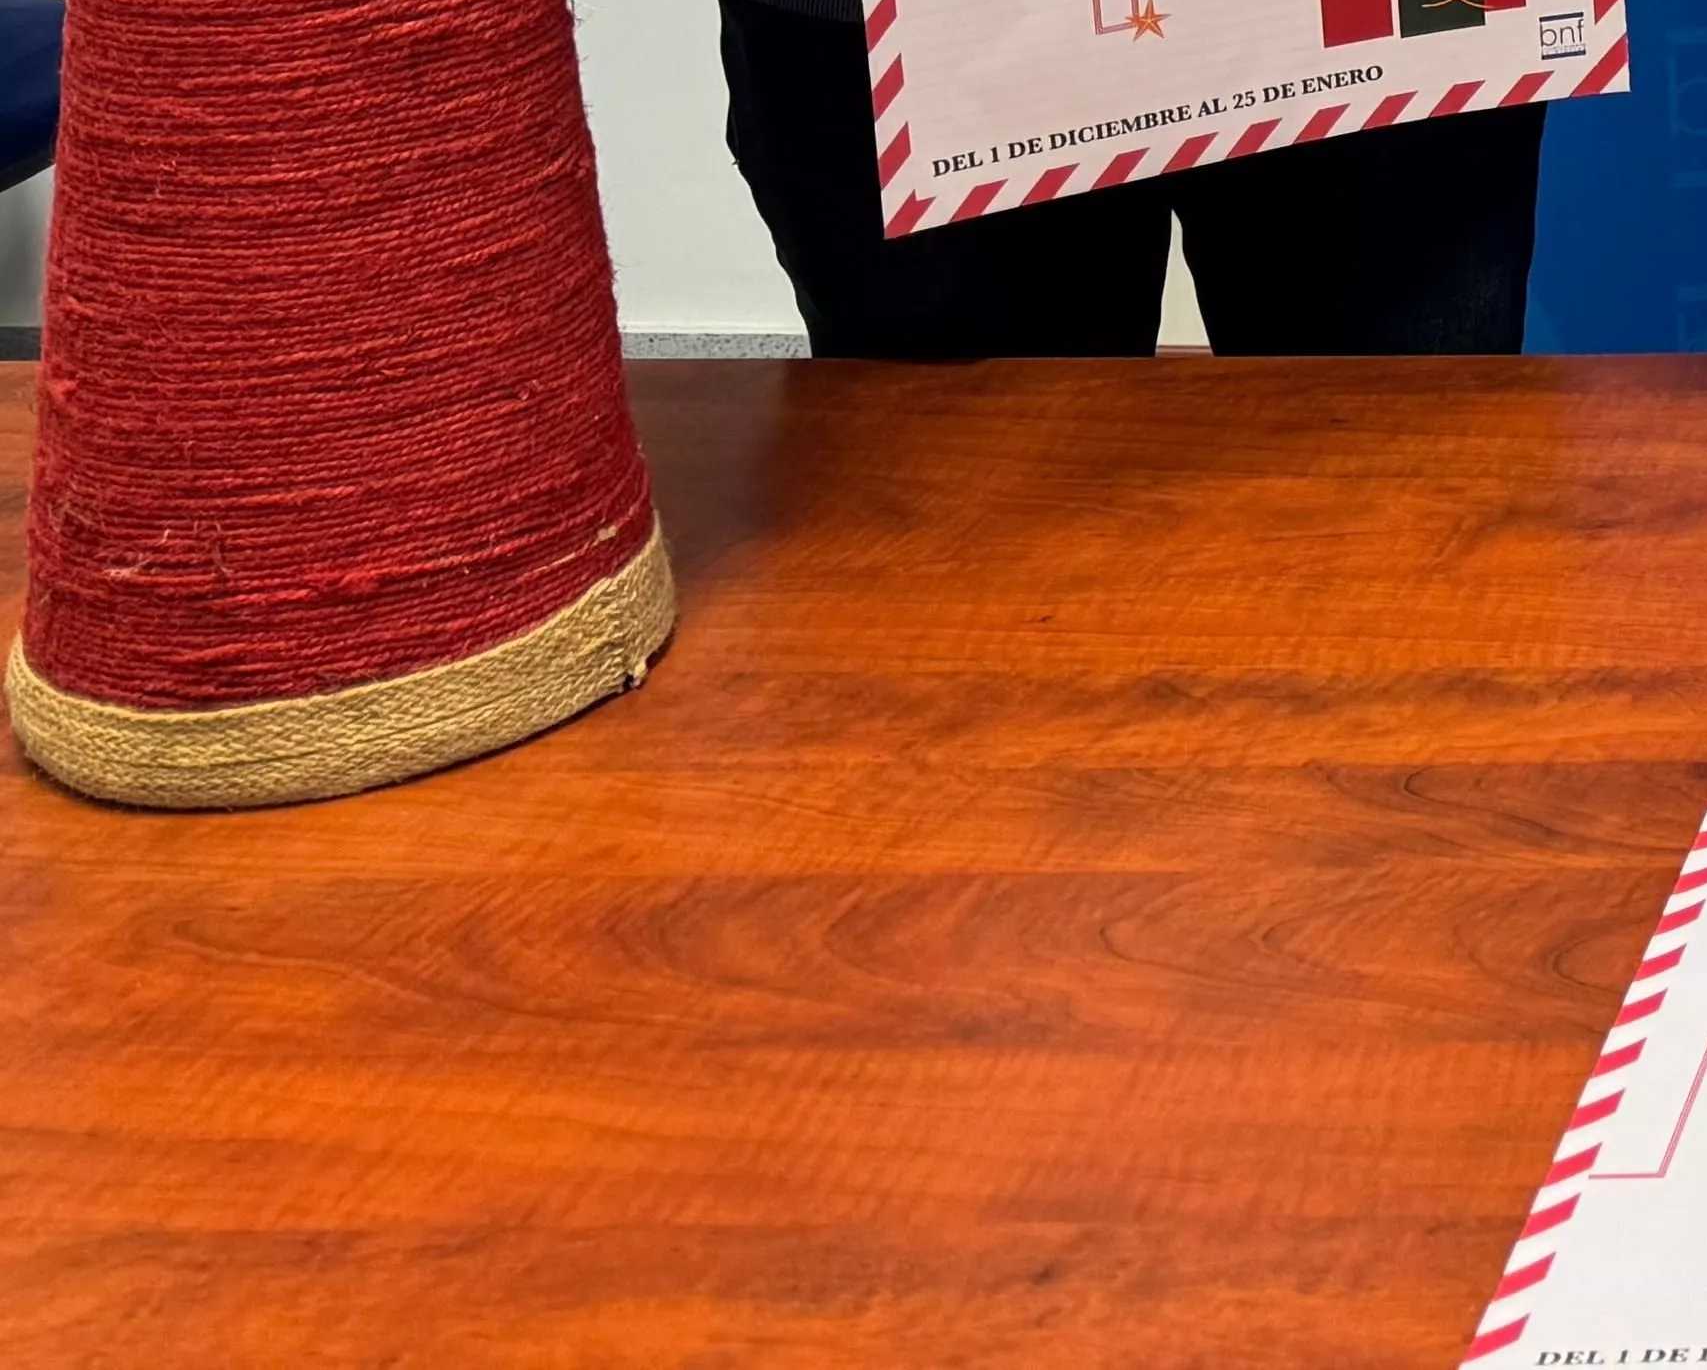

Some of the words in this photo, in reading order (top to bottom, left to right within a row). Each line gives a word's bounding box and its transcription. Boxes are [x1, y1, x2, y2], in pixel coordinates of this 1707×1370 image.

[1540, 18, 1585, 48] bnf
[931, 150, 983, 177] DEL
[990, 145, 999, 163] 1
[1007, 136, 1043, 159] DE
[1048, 104, 1192, 150] DICIEMBRE
[1197, 97, 1227, 118] AL
[1231, 90, 1256, 109] 25
[1261, 81, 1296, 103] DE
[1300, 64, 1383, 95] ENERO
[1536, 1350, 1604, 1366] DEL
[1618, 1349, 1628, 1364] 1
[1641, 1348, 1689, 1363] DE
